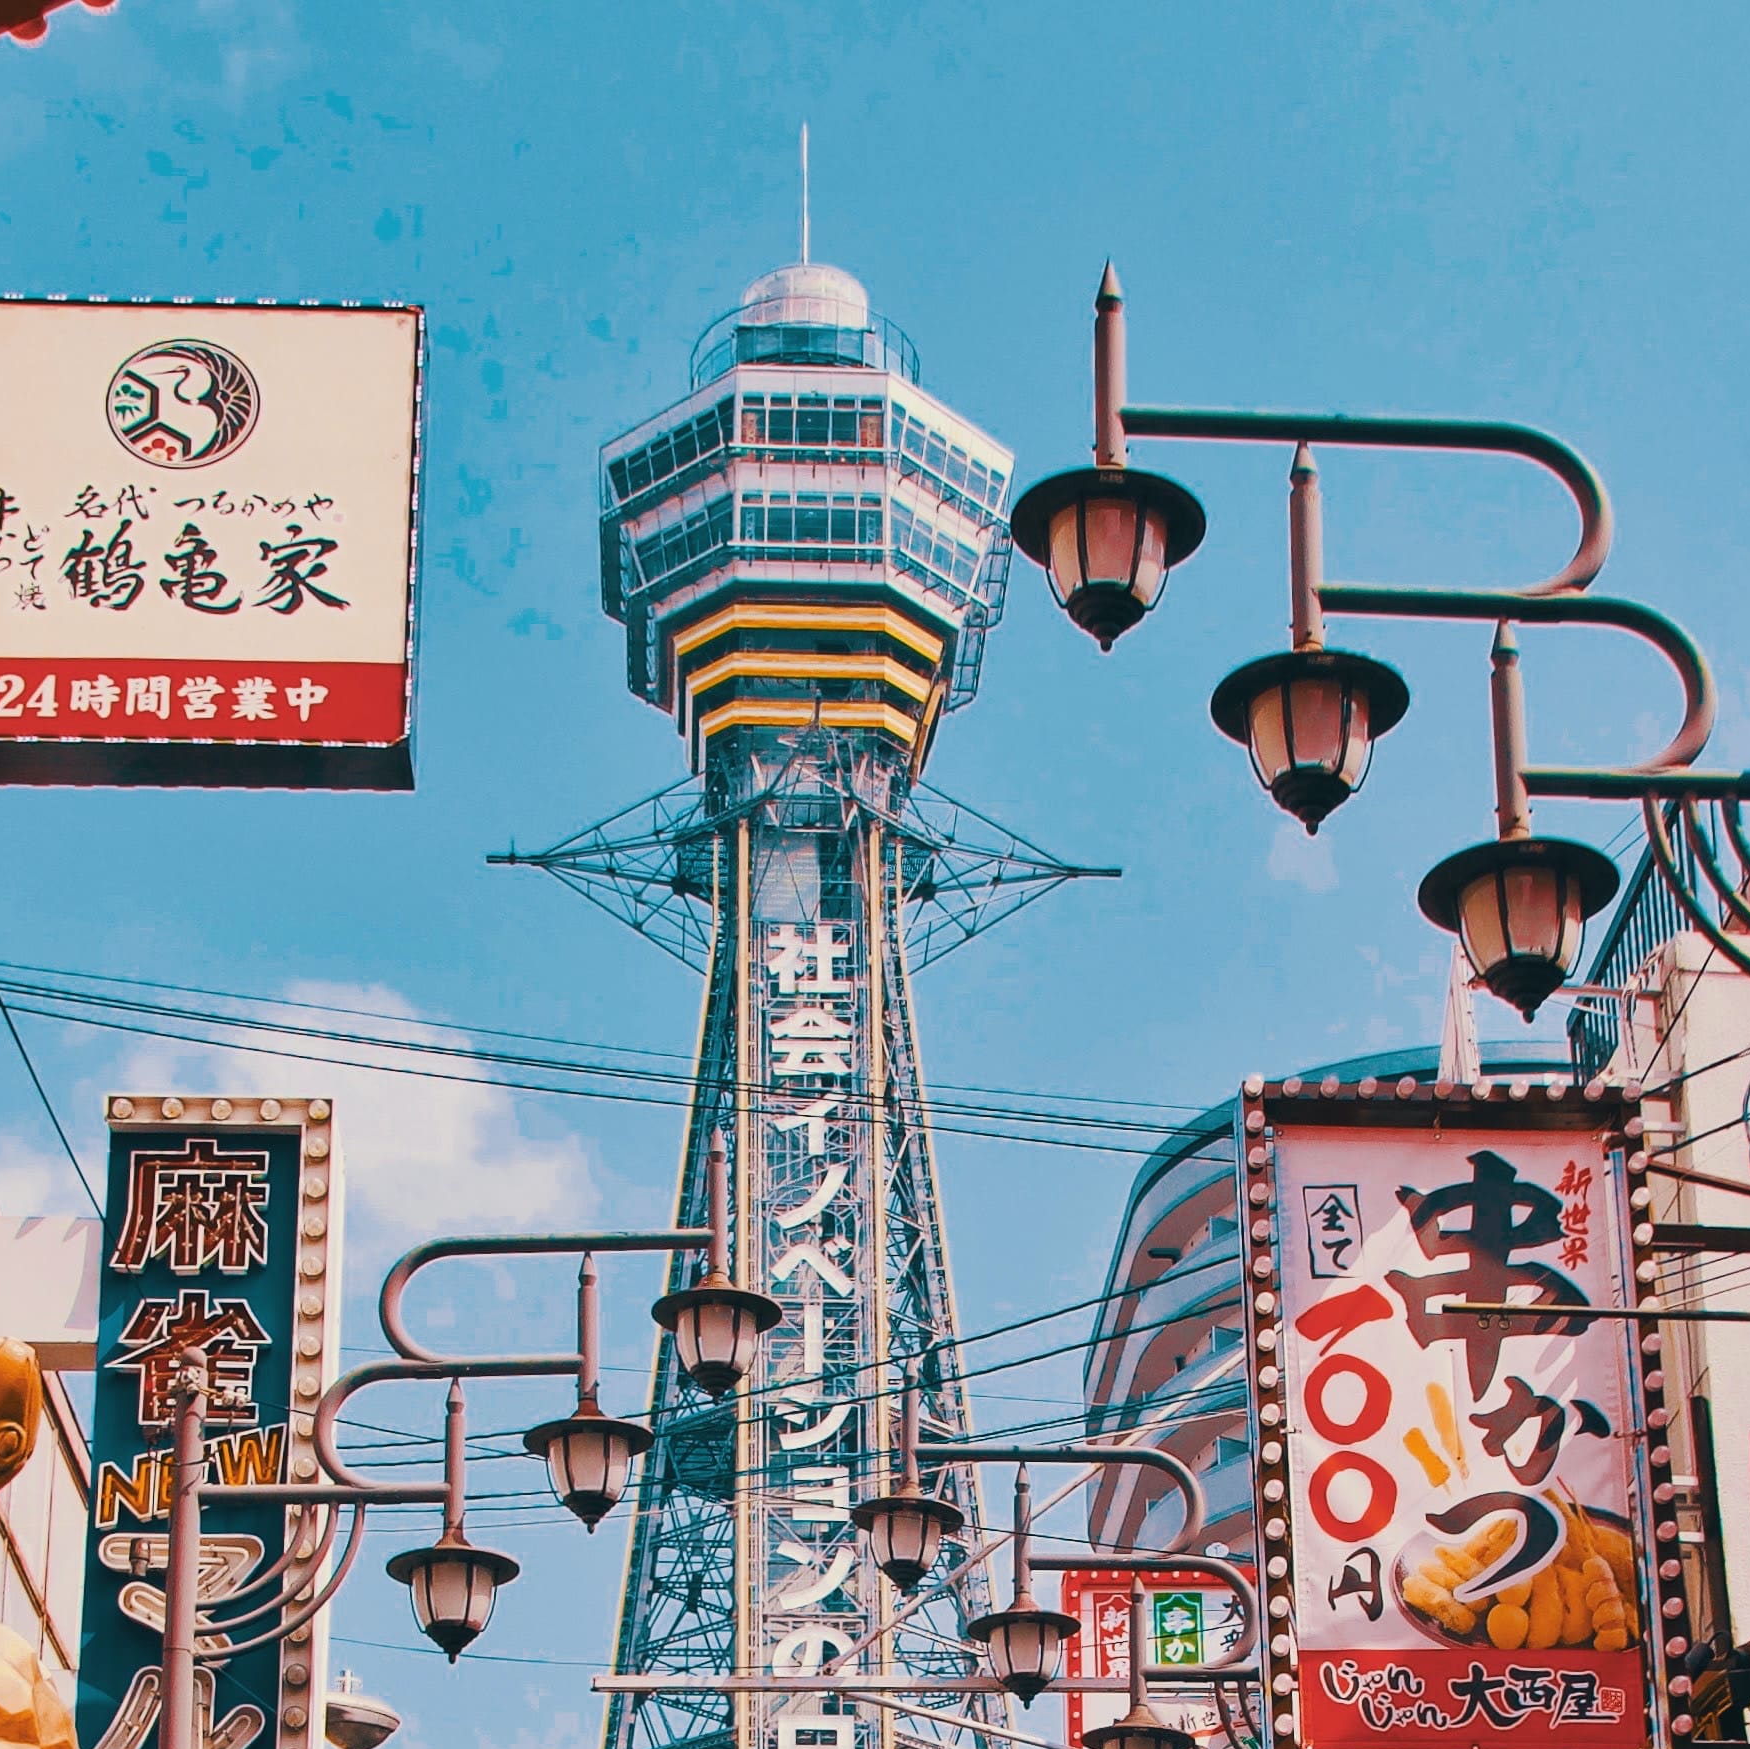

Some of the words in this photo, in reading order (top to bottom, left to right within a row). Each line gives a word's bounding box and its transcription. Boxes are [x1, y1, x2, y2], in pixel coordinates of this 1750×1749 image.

[64, 484, 156, 521] 名代
[172, 490, 334, 521] つるかめや
[12, 522, 51, 611] どて焼
[59, 519, 352, 615] 鶴亀家
[1310, 1193, 1354, 1271] 全て
[1554, 1160, 1593, 1271] 新世界
[105, 1138, 272, 1426] 麻雀
[1383, 1150, 1611, 1600] 串かつ
[1320, 1660, 1425, 1704] じゃん
[1360, 1695, 1453, 1732] じゃん
[1448, 1660, 1622, 1731] 大西屋
